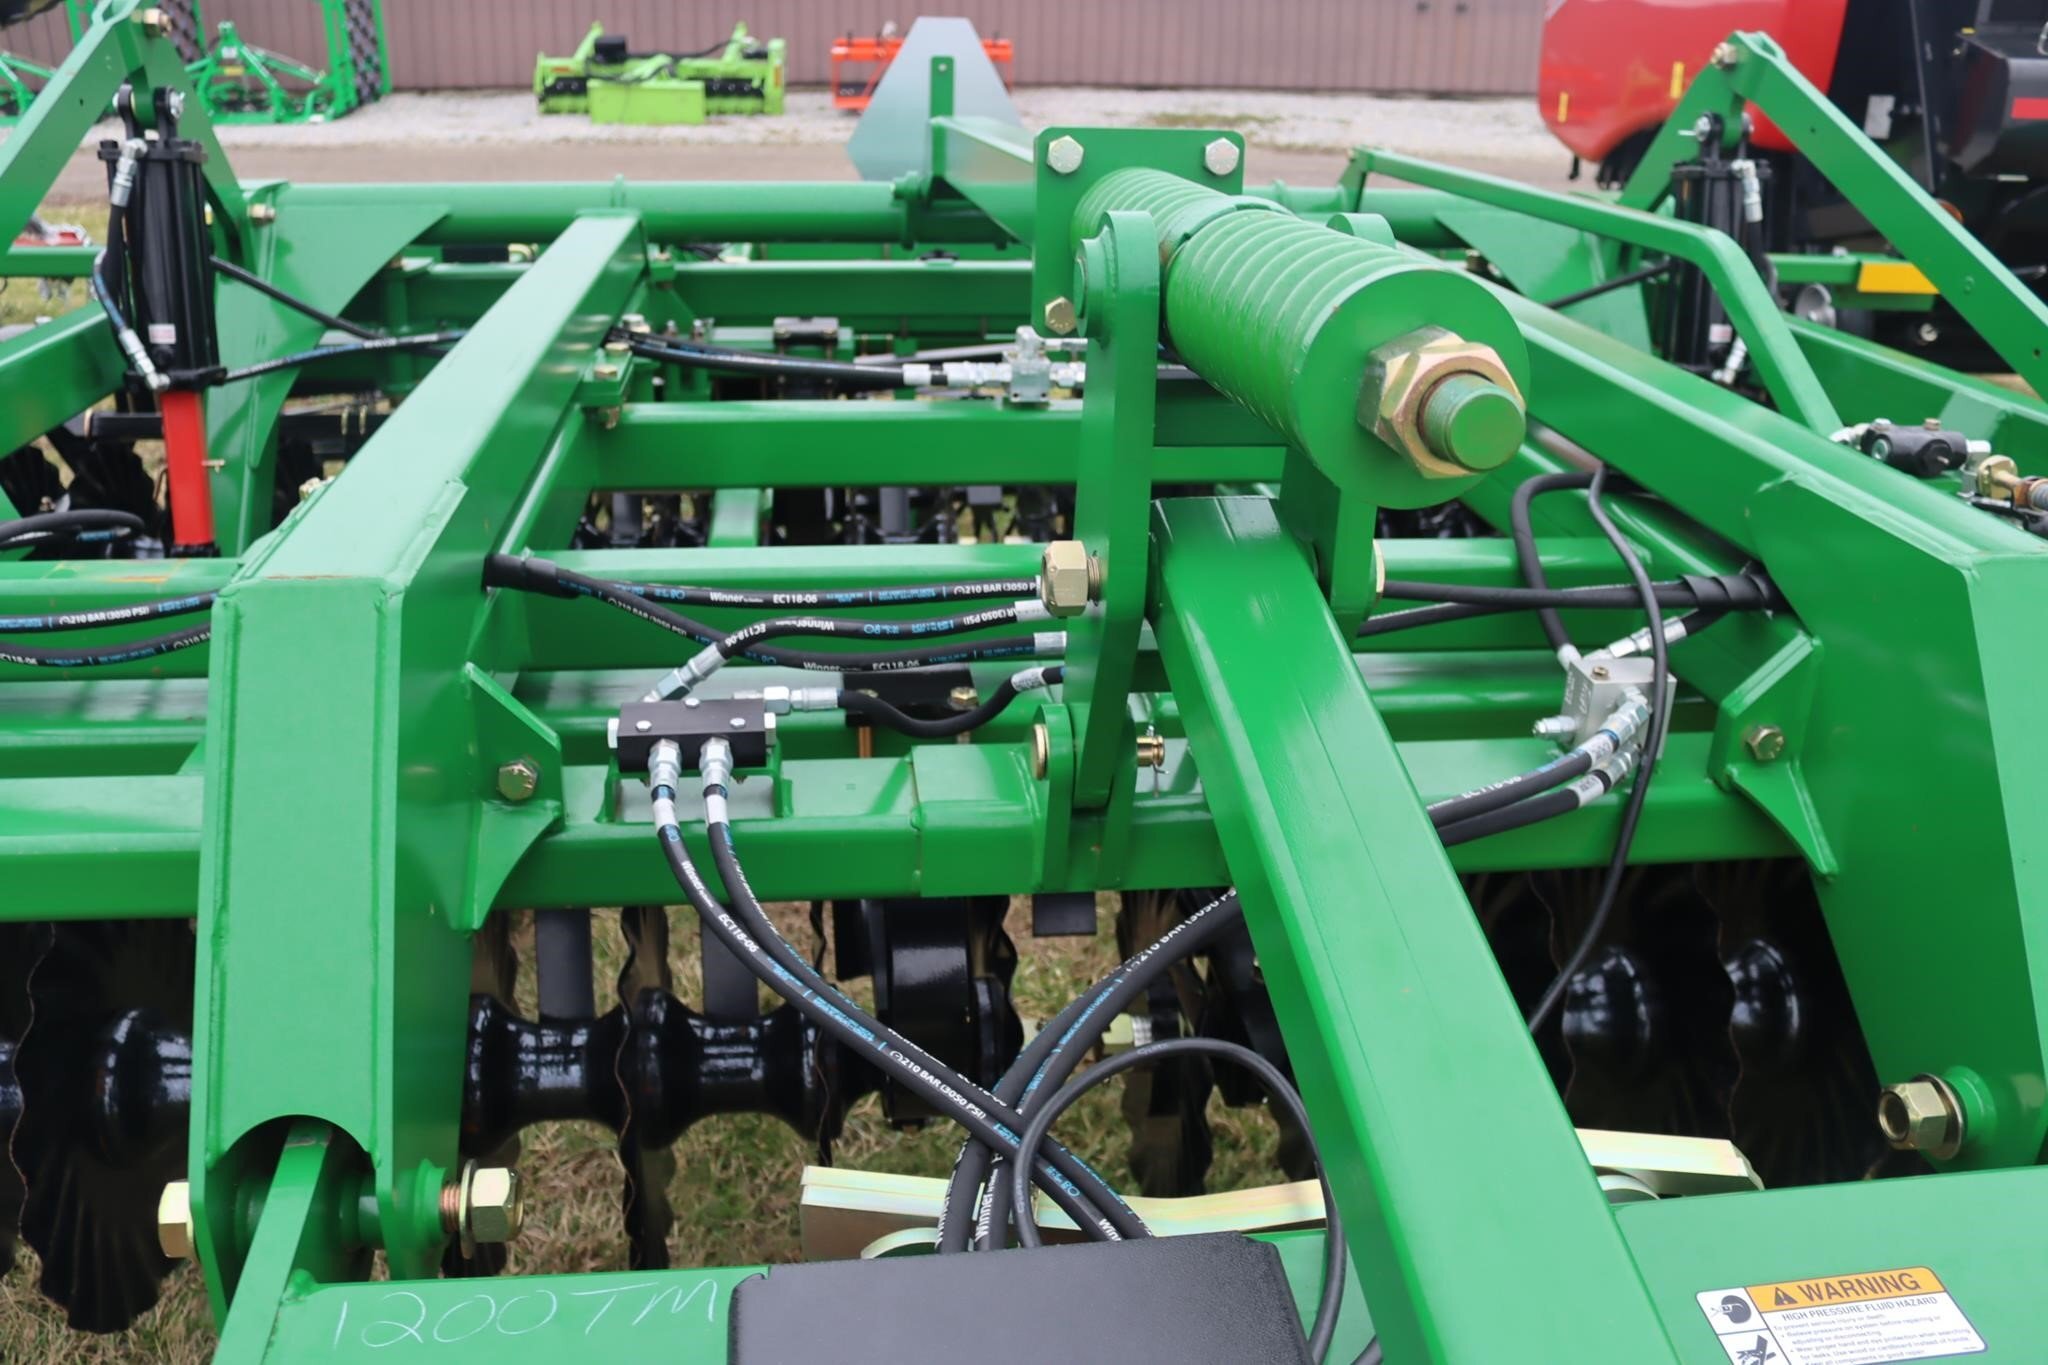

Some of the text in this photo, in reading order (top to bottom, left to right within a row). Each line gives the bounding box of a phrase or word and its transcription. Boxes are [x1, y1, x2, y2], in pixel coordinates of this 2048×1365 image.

[710, 592, 743, 602] Winner
[773, 593, 818, 604] EC118-06
[966, 584, 981, 594] 210
[983, 583, 1001, 593] BAR
[724, 623, 766, 648] EC118-06
[718, 913, 760, 953] EC118-06
[900, 1058, 921, 1073] 210
[919, 1070, 942, 1088] BAR
[1798, 1273, 1921, 1302] WARNING
[1780, 1296, 1938, 1320] HIGH PRESSURE FLUID HAZARD
